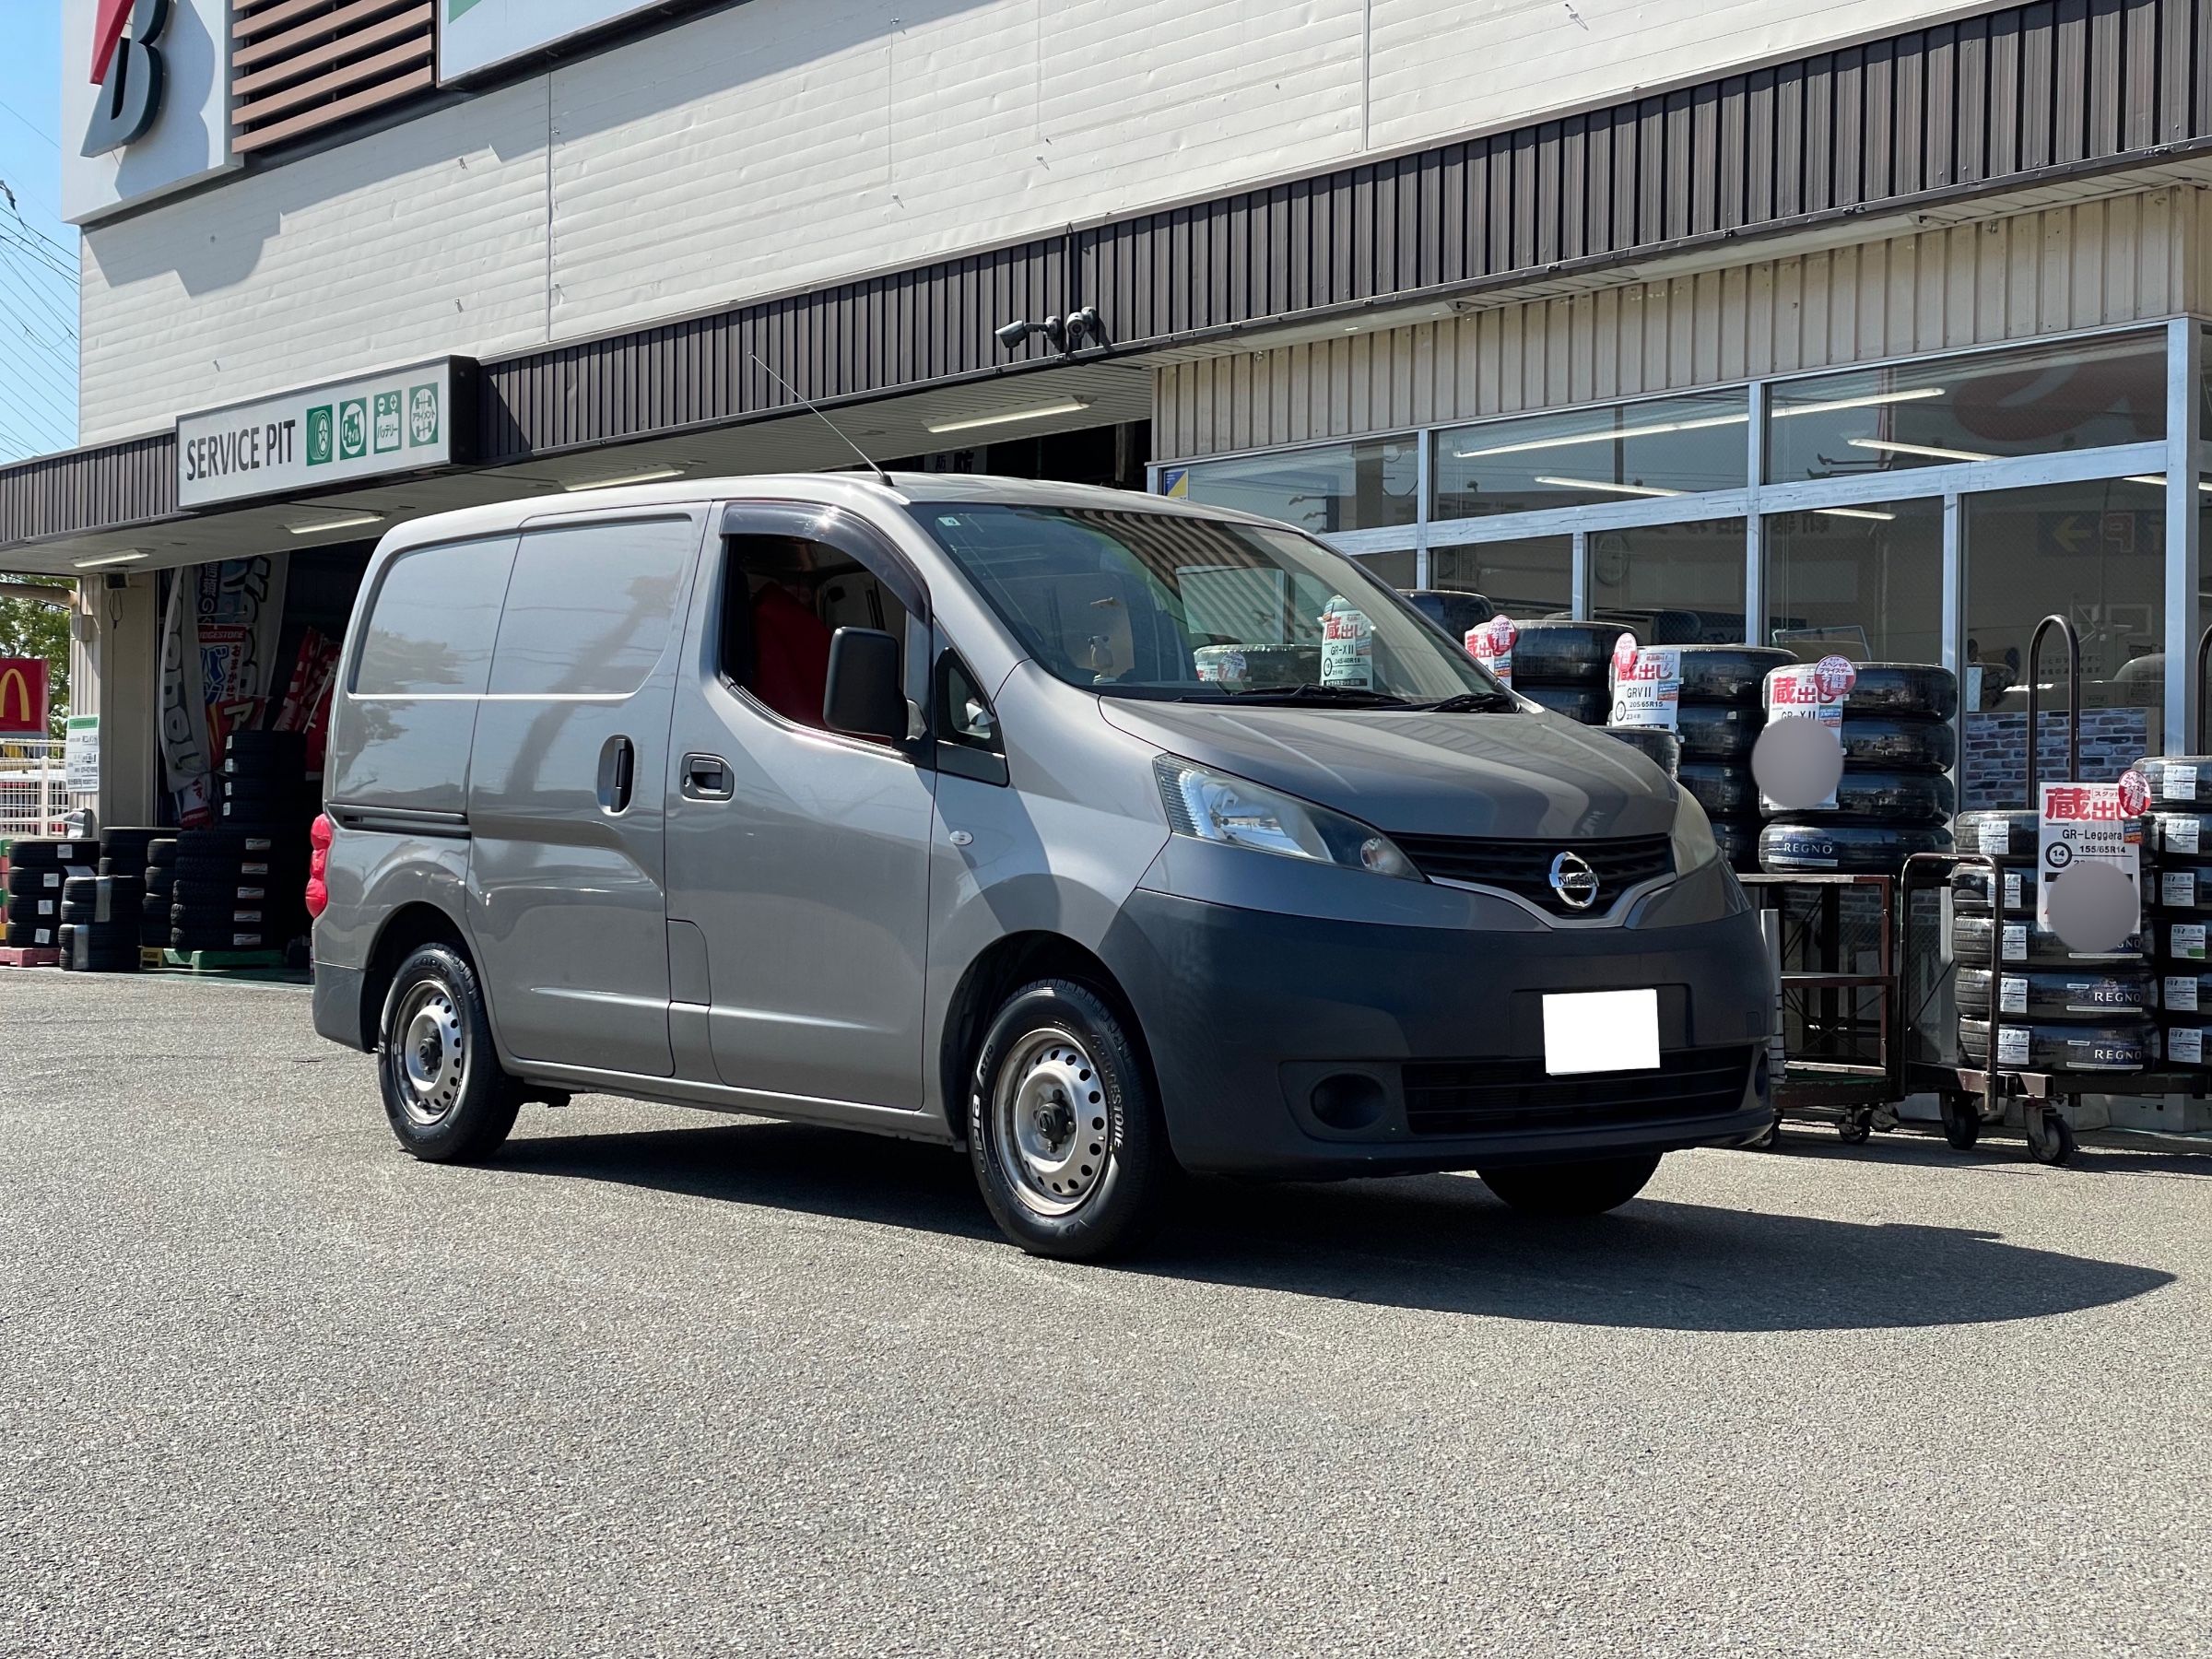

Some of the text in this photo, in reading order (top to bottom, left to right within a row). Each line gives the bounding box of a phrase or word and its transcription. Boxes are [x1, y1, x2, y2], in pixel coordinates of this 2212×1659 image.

[412, 409, 436, 422] アライメント
[377, 424, 398, 439] バッテリー
[186, 418, 296, 481] SERVICE PIT
[1325, 615, 1368, 641] 蔵出し
[199, 630, 245, 640] IDGESTONE
[1772, 677, 1838, 704] 蔵出し
[2045, 787, 2133, 820] 蔵出し
[2062, 830, 2123, 841] GR-Leggera
[1784, 842, 1833, 855] REGNO
[2079, 845, 2126, 853] 155/65R14
[1558, 875, 1598, 888] NISSAN
[2116, 938, 2141, 948] GNO
[2094, 992, 2141, 1002] REGNO
[2094, 1049, 2142, 1060] REGNO
